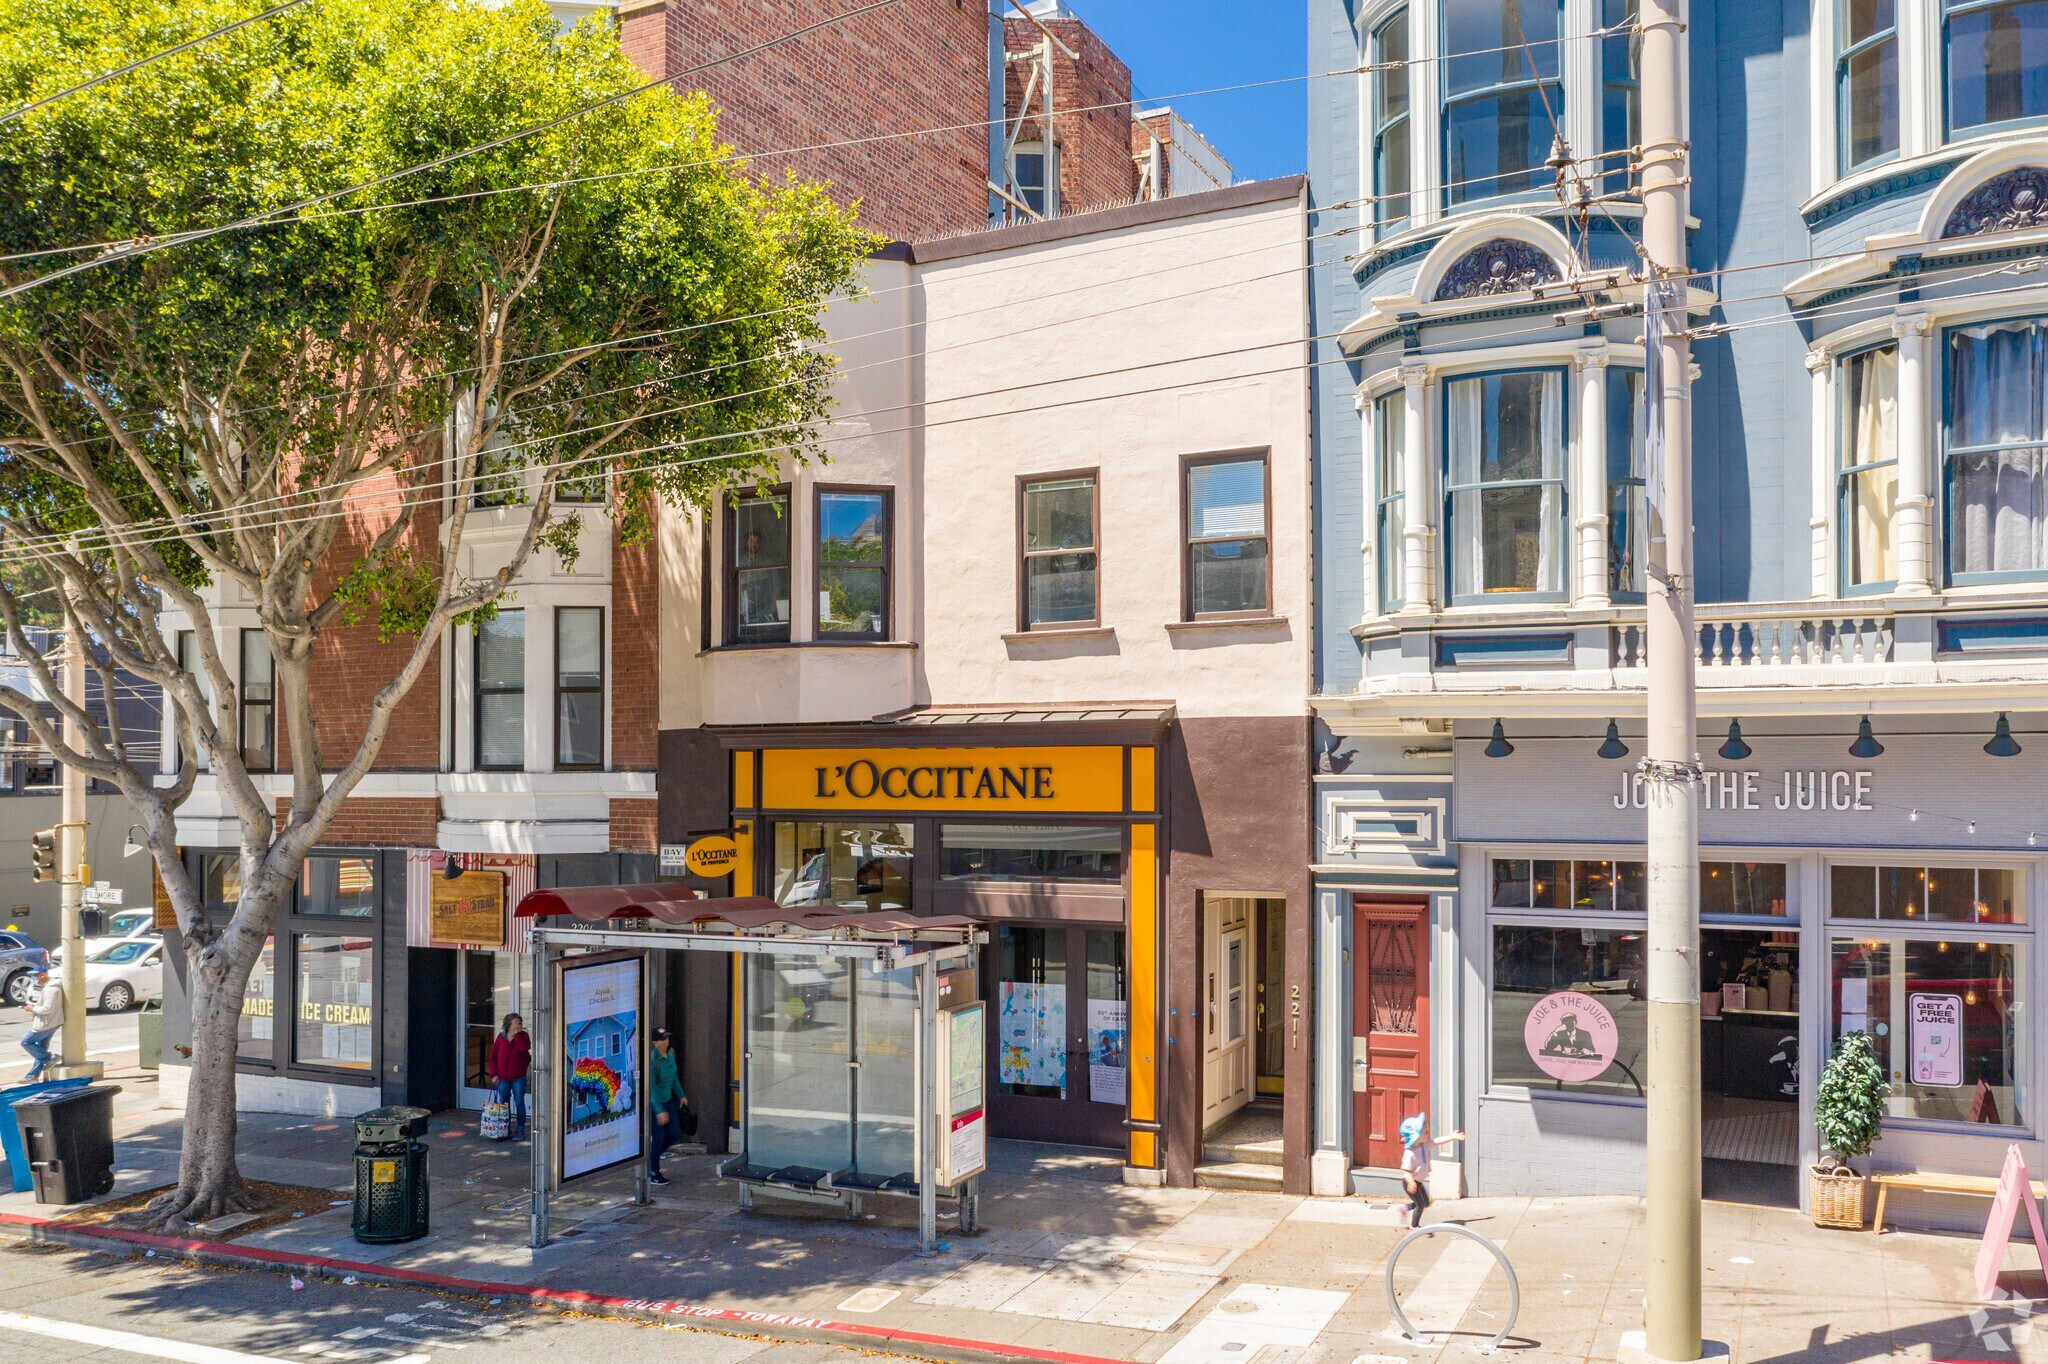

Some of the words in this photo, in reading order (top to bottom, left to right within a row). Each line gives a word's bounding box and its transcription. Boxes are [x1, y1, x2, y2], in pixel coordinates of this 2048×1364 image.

[814, 759, 1055, 799] L'OCCITANE
[1613, 771, 1649, 809] JO
[1701, 771, 1760, 810] THE
[1774, 771, 1873, 811] JUICE
[664, 848, 682, 856] BAY
[691, 848, 738, 862] L'OCCITANE
[85, 891, 116, 900] FILLMORE
[438, 903, 457, 918] SALT
[471, 897, 496, 911] STRAW
[301, 1002, 321, 1020] ICE
[325, 1003, 370, 1025] CREAM
[1532, 1004, 1550, 1025] JOE
[1549, 999, 1559, 1009] &
[1560, 996, 1582, 1008] THE
[1583, 1003, 1611, 1030] JUICE
[1916, 1002, 1942, 1010] GET
[1919, 1009, 1952, 1017] FREE
[1291, 984, 1300, 1049] 2211
[1916, 1016, 1955, 1024] JUICE
[622, 1299, 667, 1312] BUS
[671, 1304, 724, 1317] STOP
